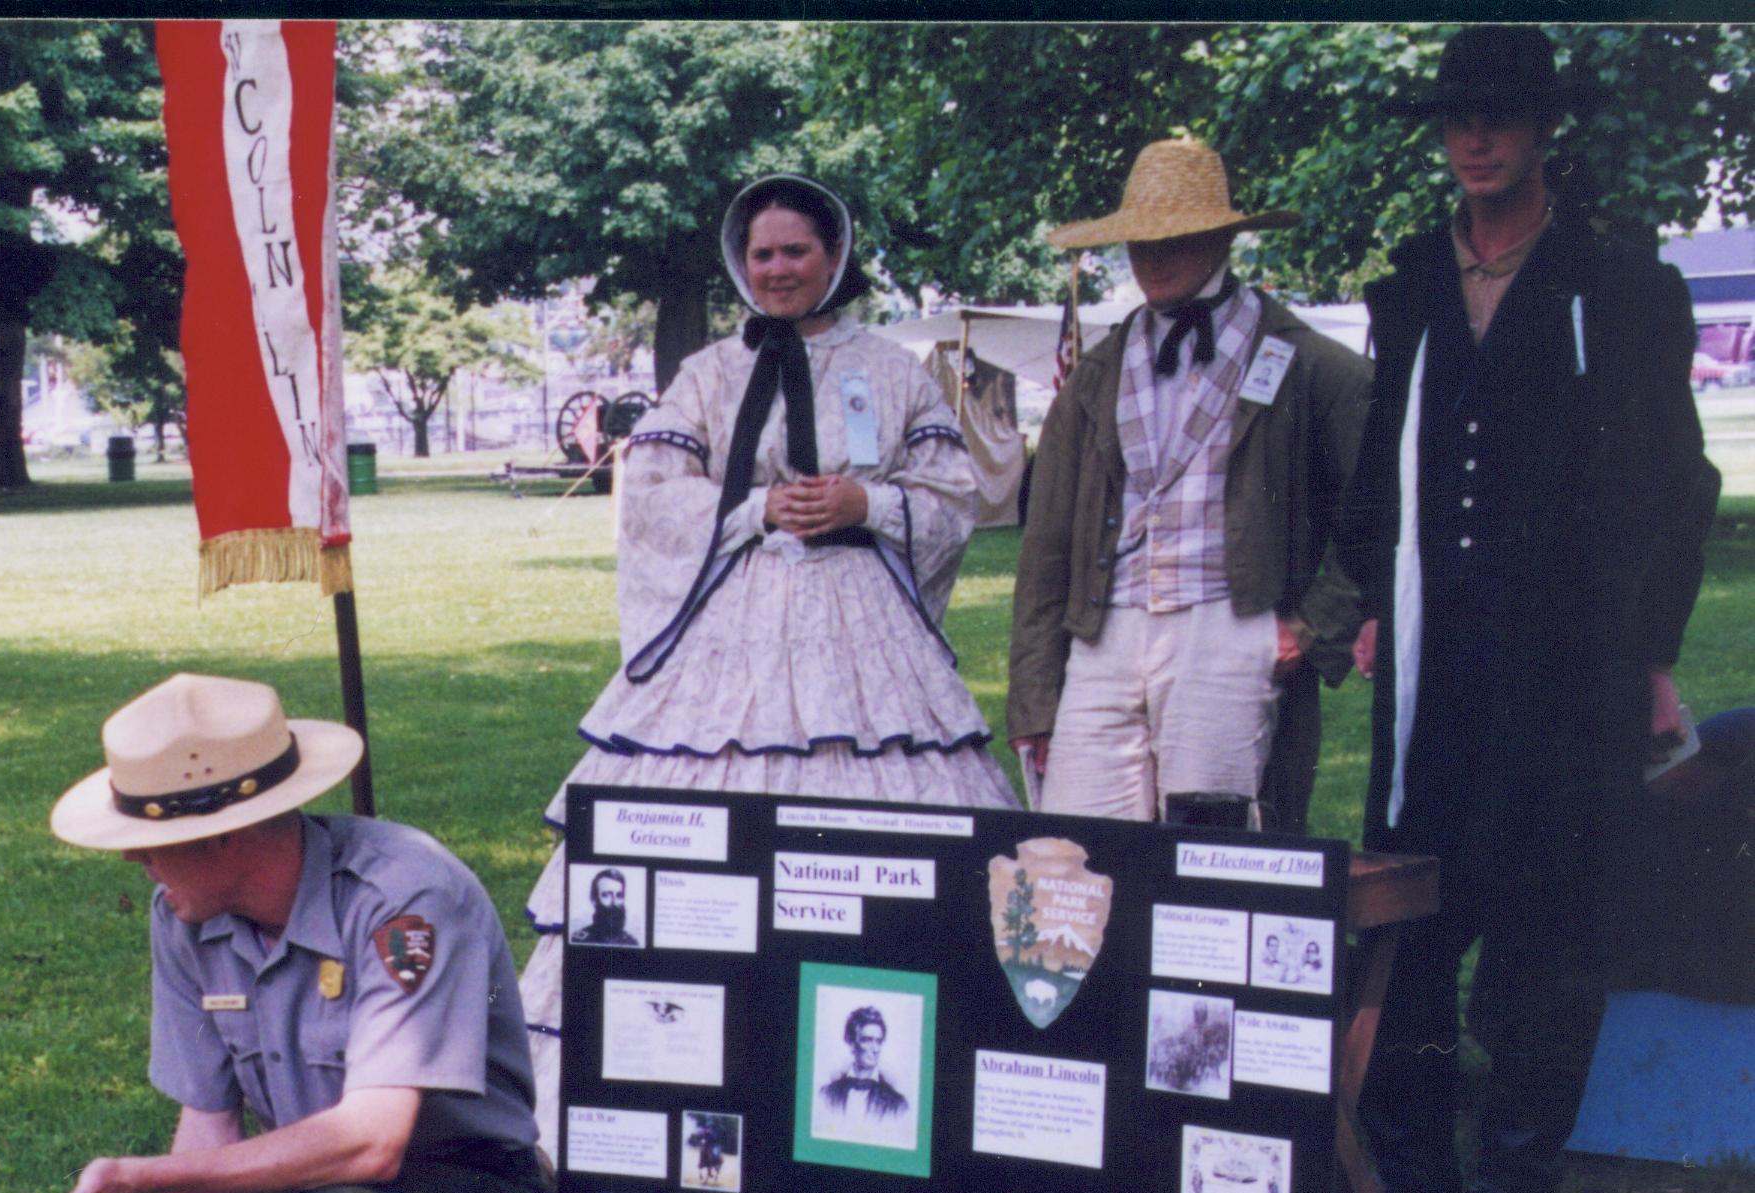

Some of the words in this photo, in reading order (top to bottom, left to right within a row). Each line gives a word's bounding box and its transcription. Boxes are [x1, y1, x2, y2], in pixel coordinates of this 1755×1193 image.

[616, 807, 684, 826] Benjamin
[688, 812, 706, 828] H.
[630, 829, 692, 848] Grierson
[1181, 849, 1206, 866] The
[1209, 852, 1264, 869] Election
[1268, 856, 1283, 874] of
[1287, 856, 1321, 875] 1860
[779, 860, 860, 883] National
[876, 866, 922, 886] Park
[1037, 877, 1105, 897] NATIONAL
[777, 899, 847, 922] Service
[1052, 894, 1087, 909] PARK
[1041, 907, 1097, 925] SERVICE
[980, 1057, 1043, 1077] Abraham
[1048, 1064, 1100, 1085] Lincoln
